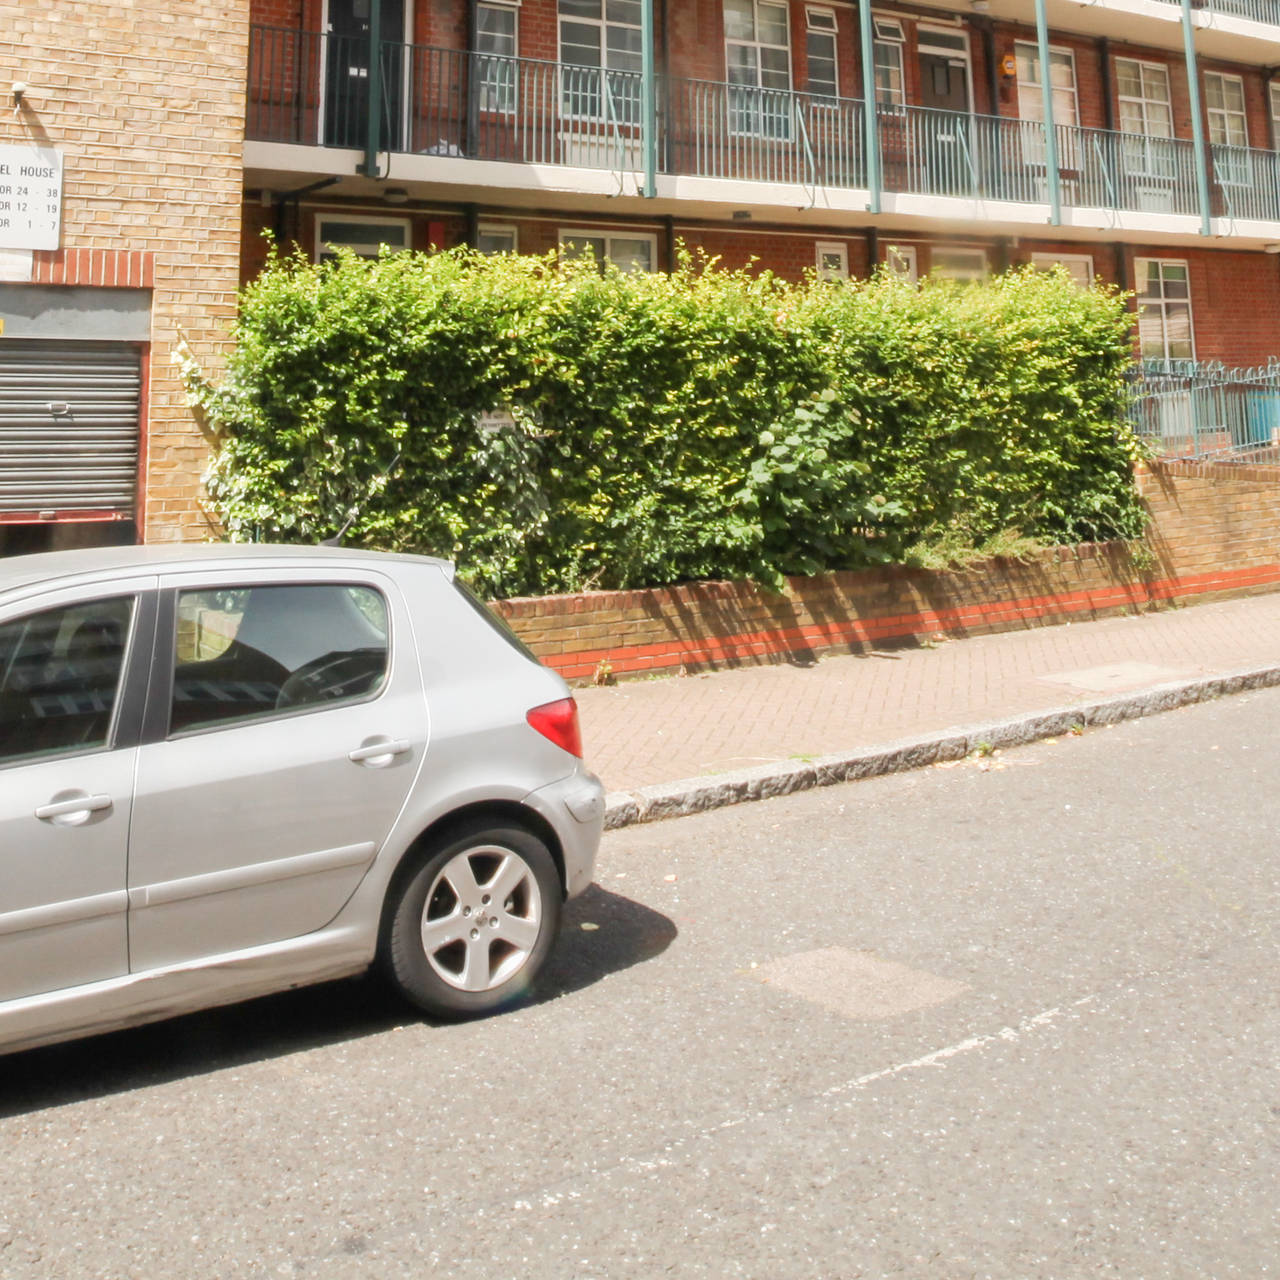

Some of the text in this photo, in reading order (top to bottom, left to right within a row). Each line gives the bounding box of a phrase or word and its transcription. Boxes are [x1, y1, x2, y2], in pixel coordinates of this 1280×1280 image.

[20, 166, 55, 178] HOUSE
[16, 187, 29, 196] 24
[46, 188, 58, 198] 38
[17, 202, 28, 212] 12
[46, 204, 57, 214] 19
[28, 220, 32, 229] 1
[51, 221, 56, 230] 7
